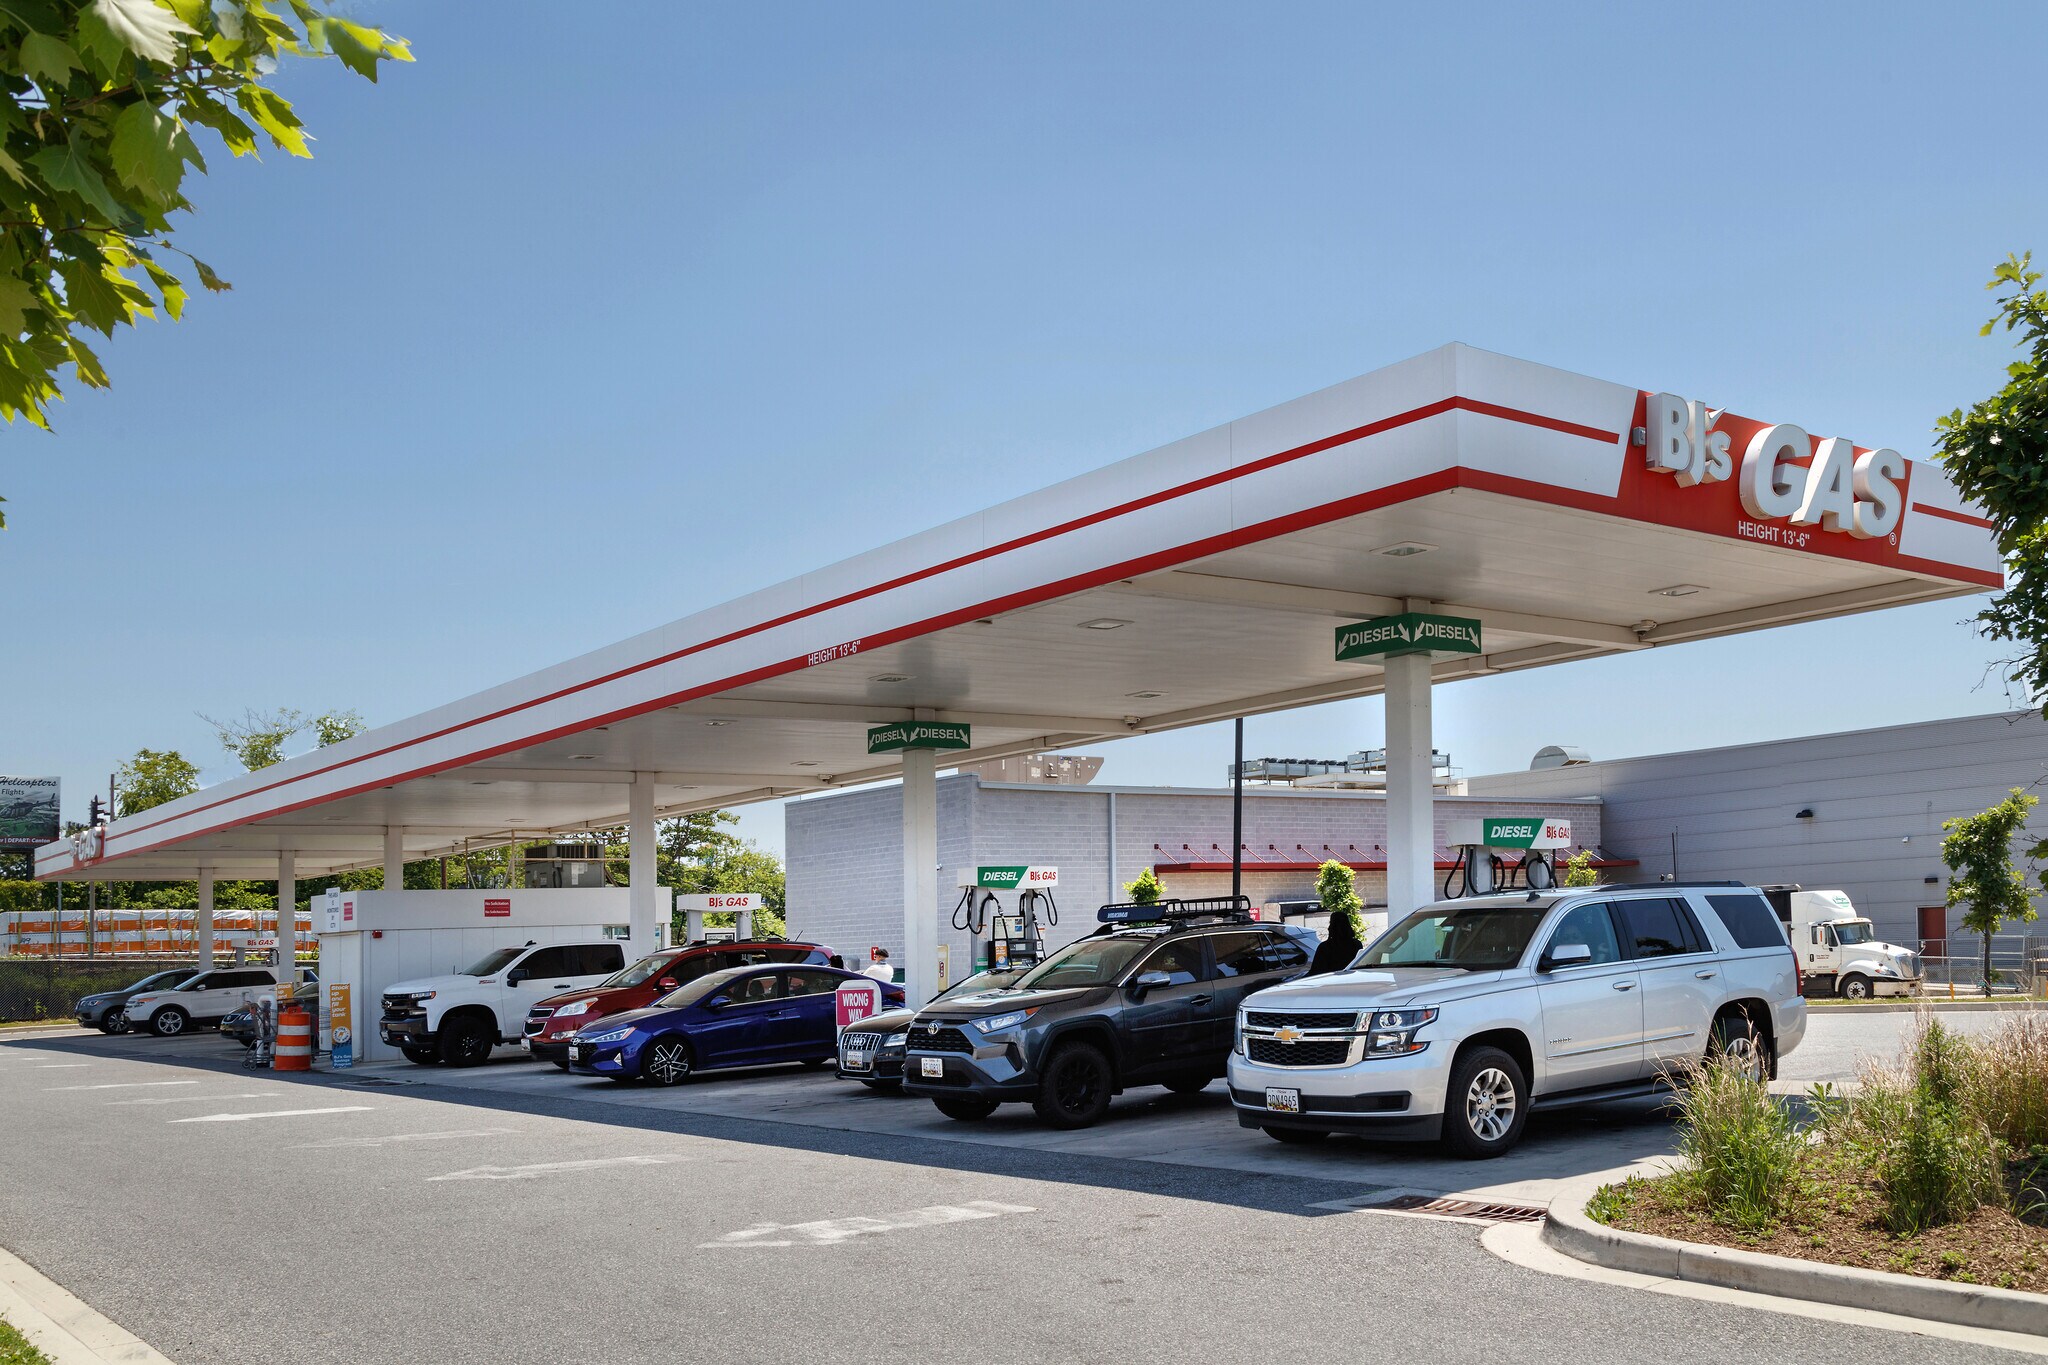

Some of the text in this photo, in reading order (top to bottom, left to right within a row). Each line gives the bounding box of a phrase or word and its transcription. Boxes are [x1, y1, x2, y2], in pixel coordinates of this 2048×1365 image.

[1646, 392, 1733, 488] BJ's
[1738, 423, 1905, 540] GAS
[1738, 520, 1811, 548] HEIGHT 13'-6"
[1349, 626, 1399, 646] DIESEL
[1425, 623, 1470, 641] DIESEL
[807, 647, 838, 666] HEIGHT
[875, 729, 901, 744] DIESEL
[920, 728, 960, 740] DIESEL
[0, 776, 57, 788] Helicopters
[1490, 826, 1533, 838] DIESEL
[1546, 826, 1570, 839] BJ's GAS
[983, 872, 1019, 881] DIESEL
[1030, 871, 1057, 881] BJ's GAS
[708, 896, 749, 908] BJ's GAS
[842, 992, 868, 1006] WRONG
[848, 1008, 864, 1022] WAY
